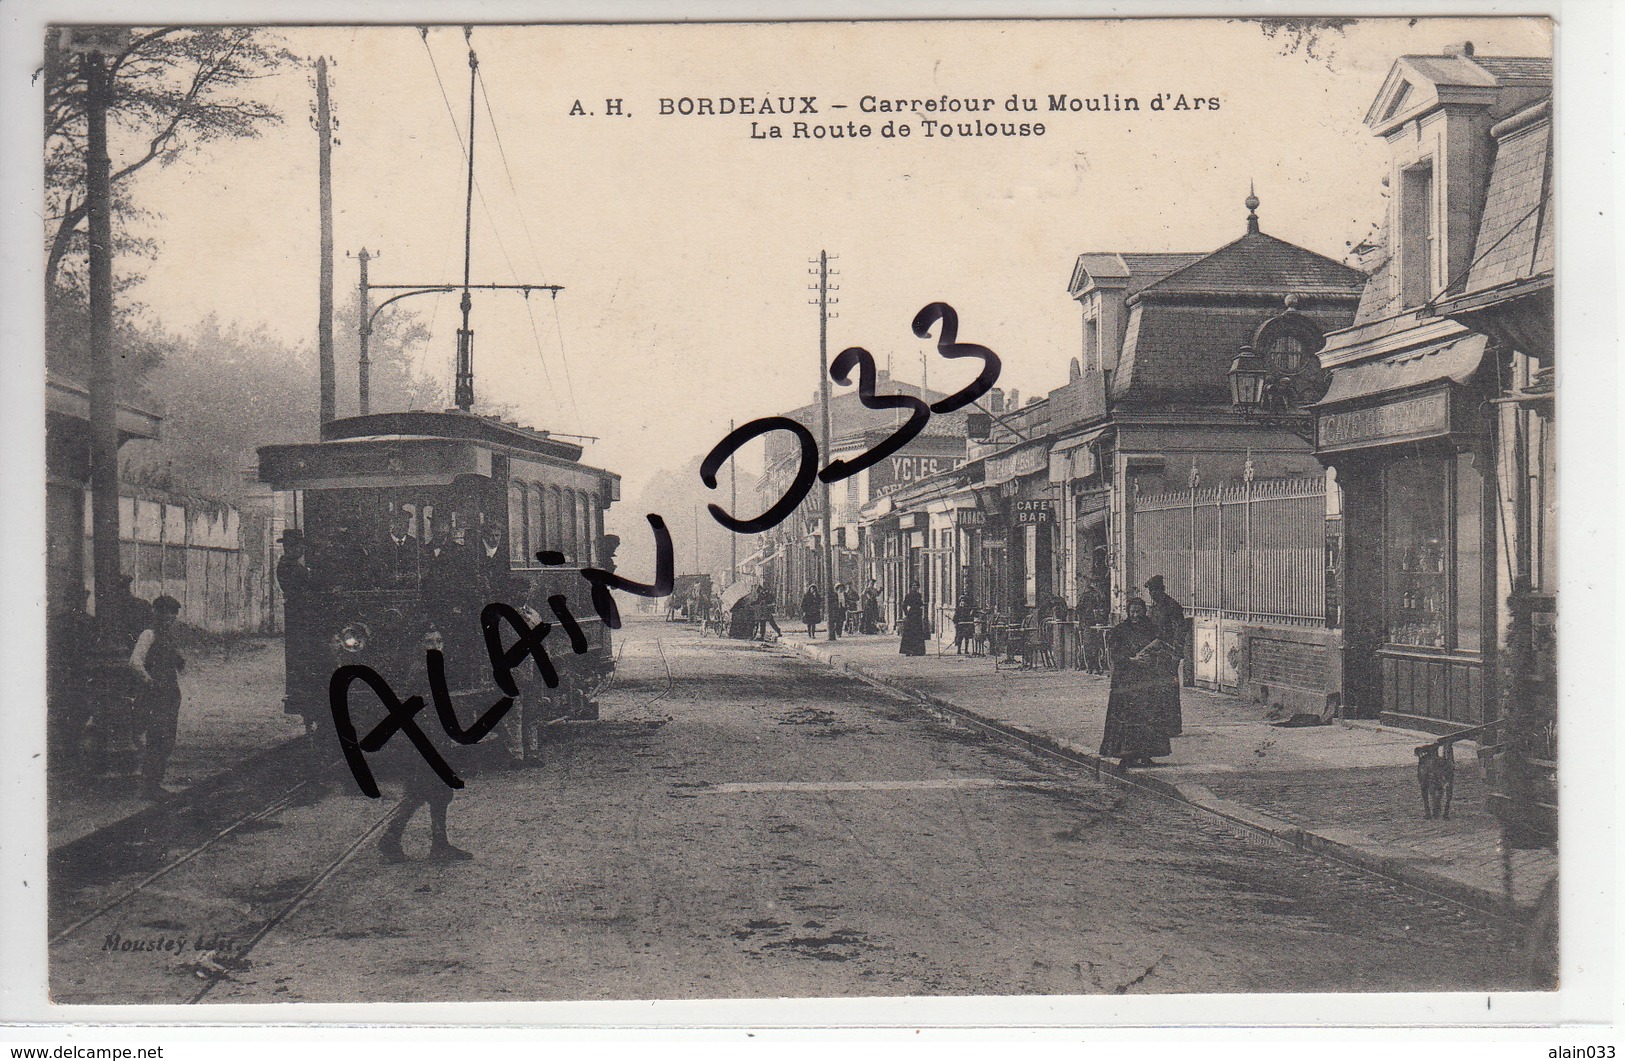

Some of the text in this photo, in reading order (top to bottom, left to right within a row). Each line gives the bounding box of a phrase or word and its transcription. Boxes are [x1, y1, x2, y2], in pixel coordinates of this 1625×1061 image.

[700, 301, 1001, 534] 033
[1016, 501, 1048, 511] CAFE
[1019, 512, 1047, 522] BAR
